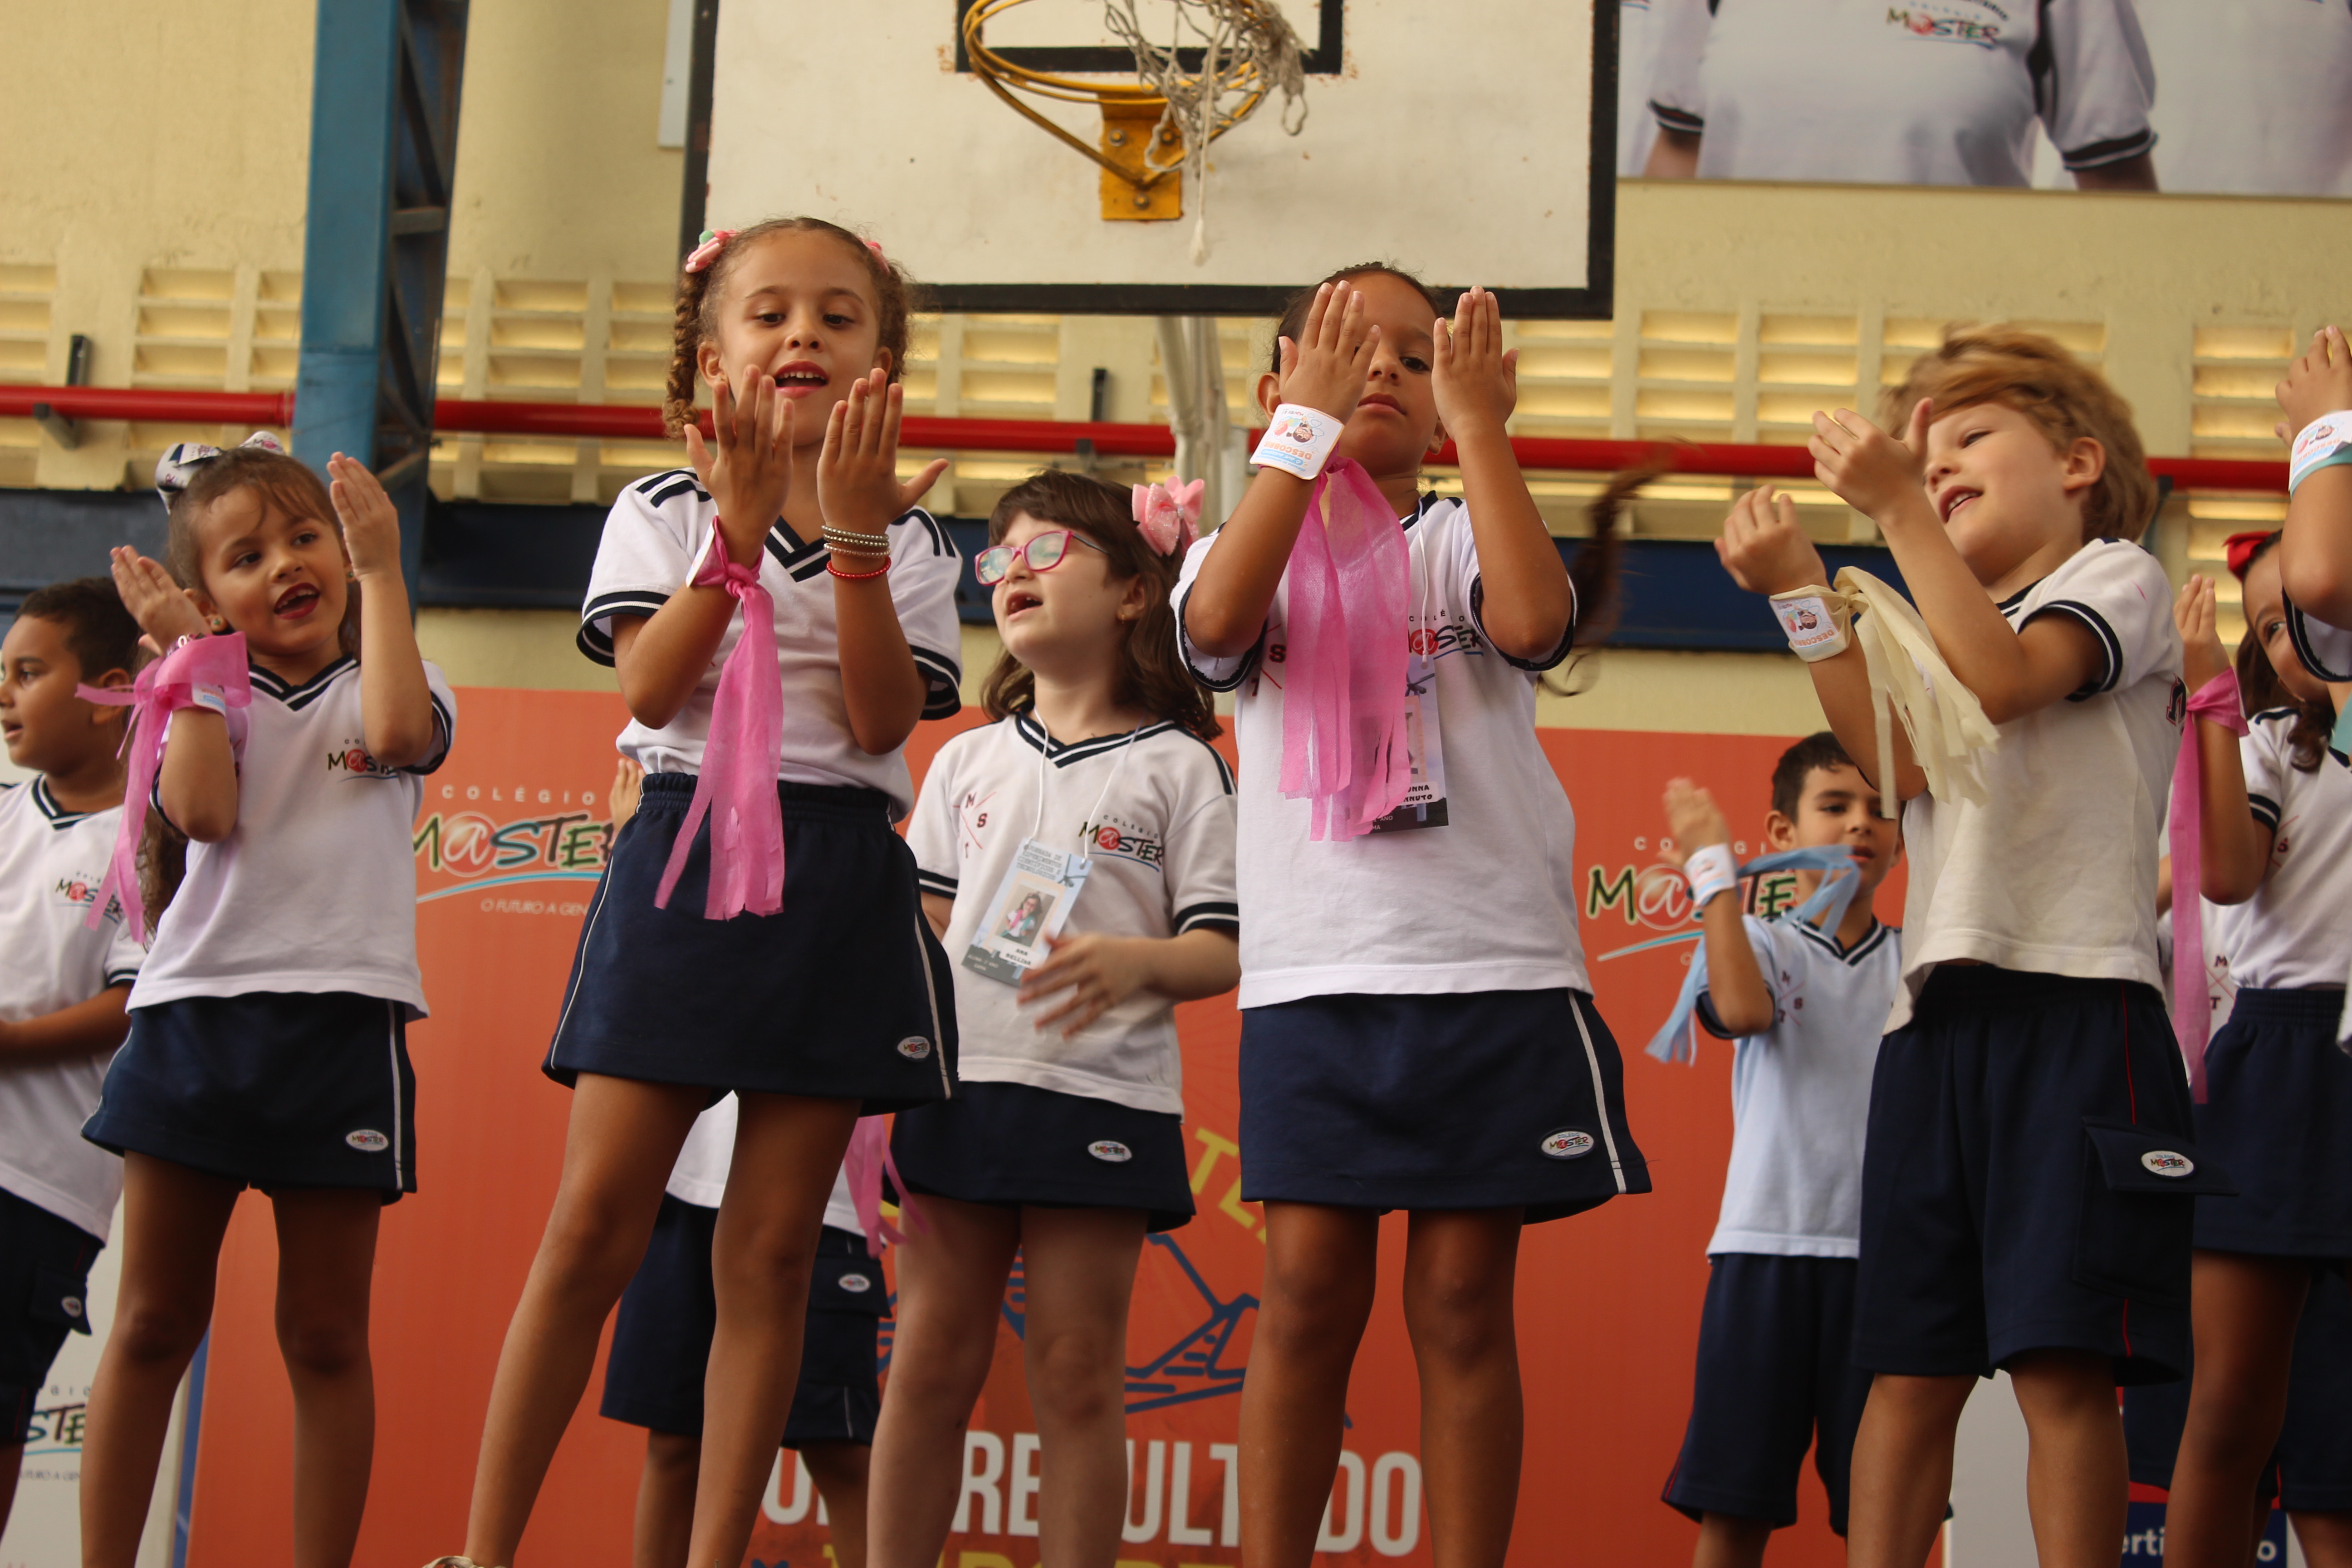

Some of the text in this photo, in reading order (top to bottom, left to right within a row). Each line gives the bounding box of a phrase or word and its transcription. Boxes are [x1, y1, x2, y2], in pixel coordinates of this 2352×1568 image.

[441, 784, 596, 805] COLÉGIO
[976, 812, 988, 828] S
[495, 899, 544, 914] FUTURO
[546, 902, 557, 915] A
[2209, 996, 2222, 1009] T
[951, 1431, 1419, 1556] REULTDO
